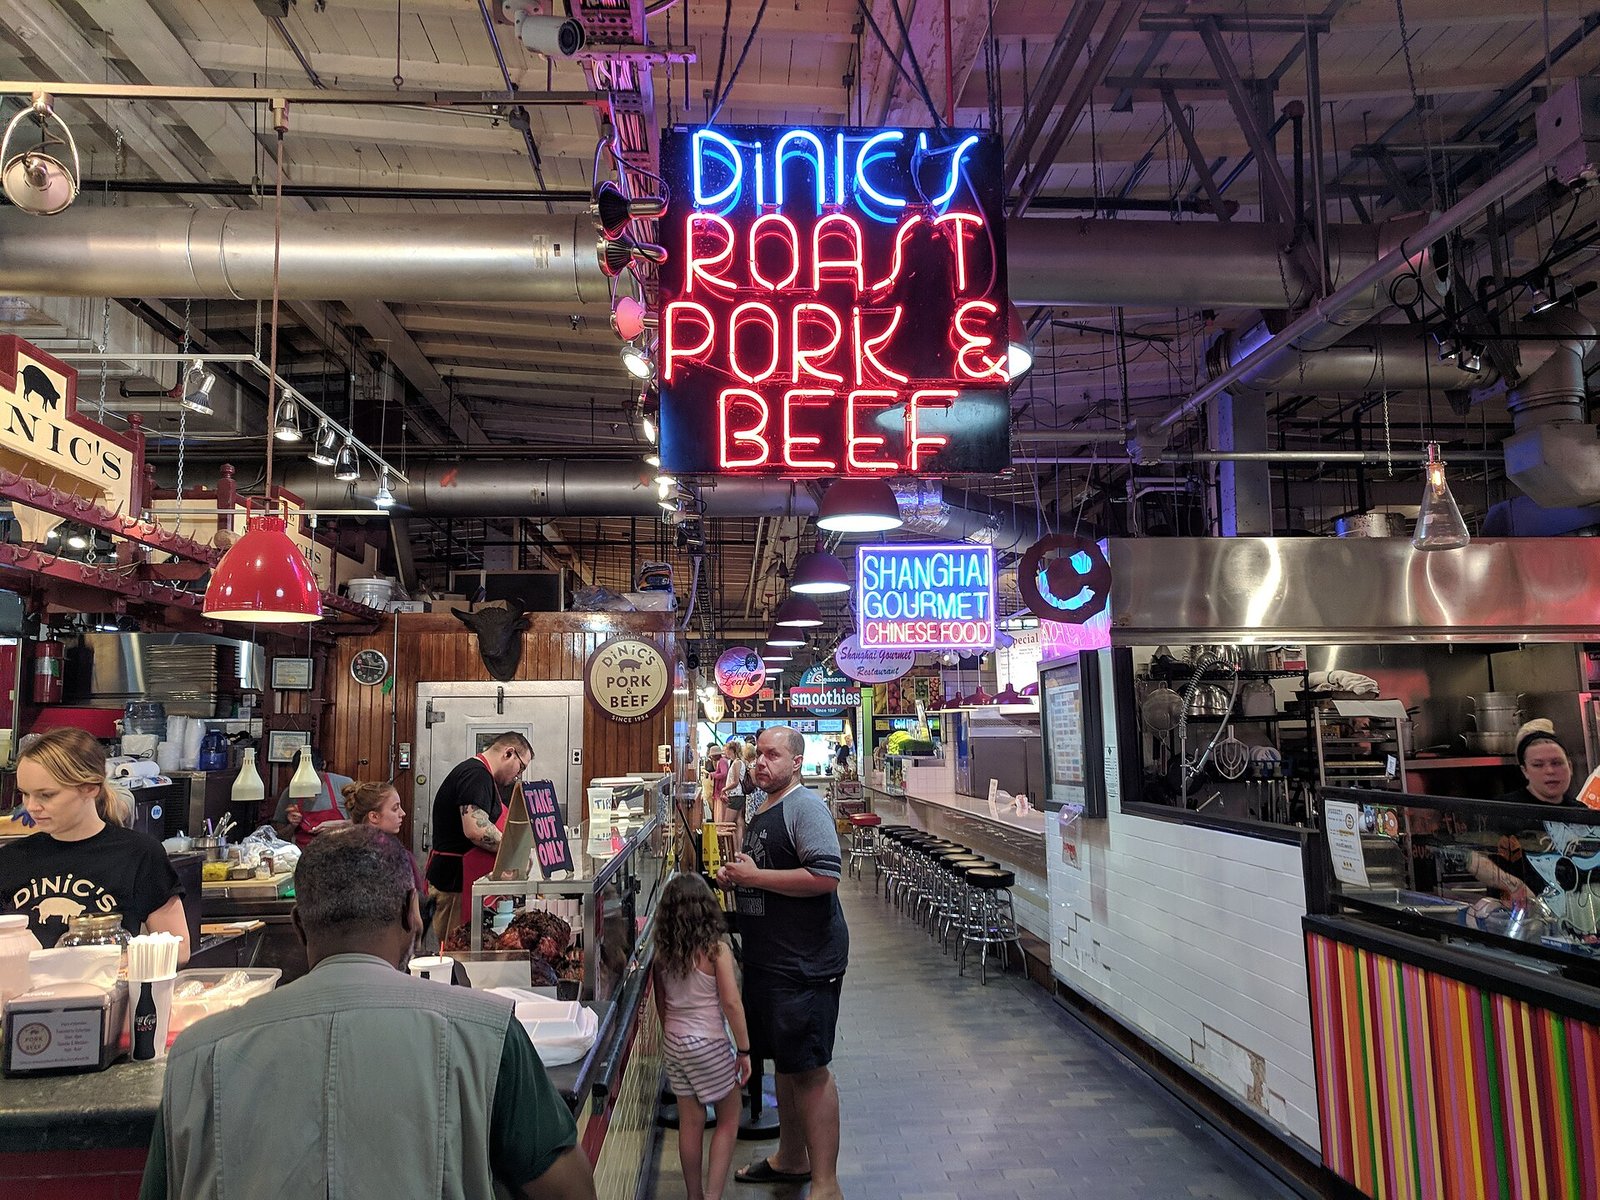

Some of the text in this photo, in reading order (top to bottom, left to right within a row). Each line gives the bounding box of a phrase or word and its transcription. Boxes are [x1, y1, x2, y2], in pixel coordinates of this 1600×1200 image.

[685, 212, 984, 293] ROAST
[663, 300, 1010, 386] PORK &
[719, 388, 960, 471] BEEF
[863, 552, 989, 590] SHANGHAI
[863, 590, 989, 620] GOURMET
[866, 620, 989, 643] CHINESE FOOD
[1013, 632, 1040, 648] pecial
[840, 646, 912, 664] Shanghai Gourmet
[606, 675, 652, 689] PORK
[856, 665, 900, 677] Restaurant
[610, 694, 649, 708] BEEF
[626, 687, 633, 695] &
[791, 688, 861, 706] smoothies
[611, 713, 649, 723] SINCE 1954
[524, 788, 556, 814] TAKE
[534, 816, 558, 840] OUT
[538, 840, 565, 866] ONLY
